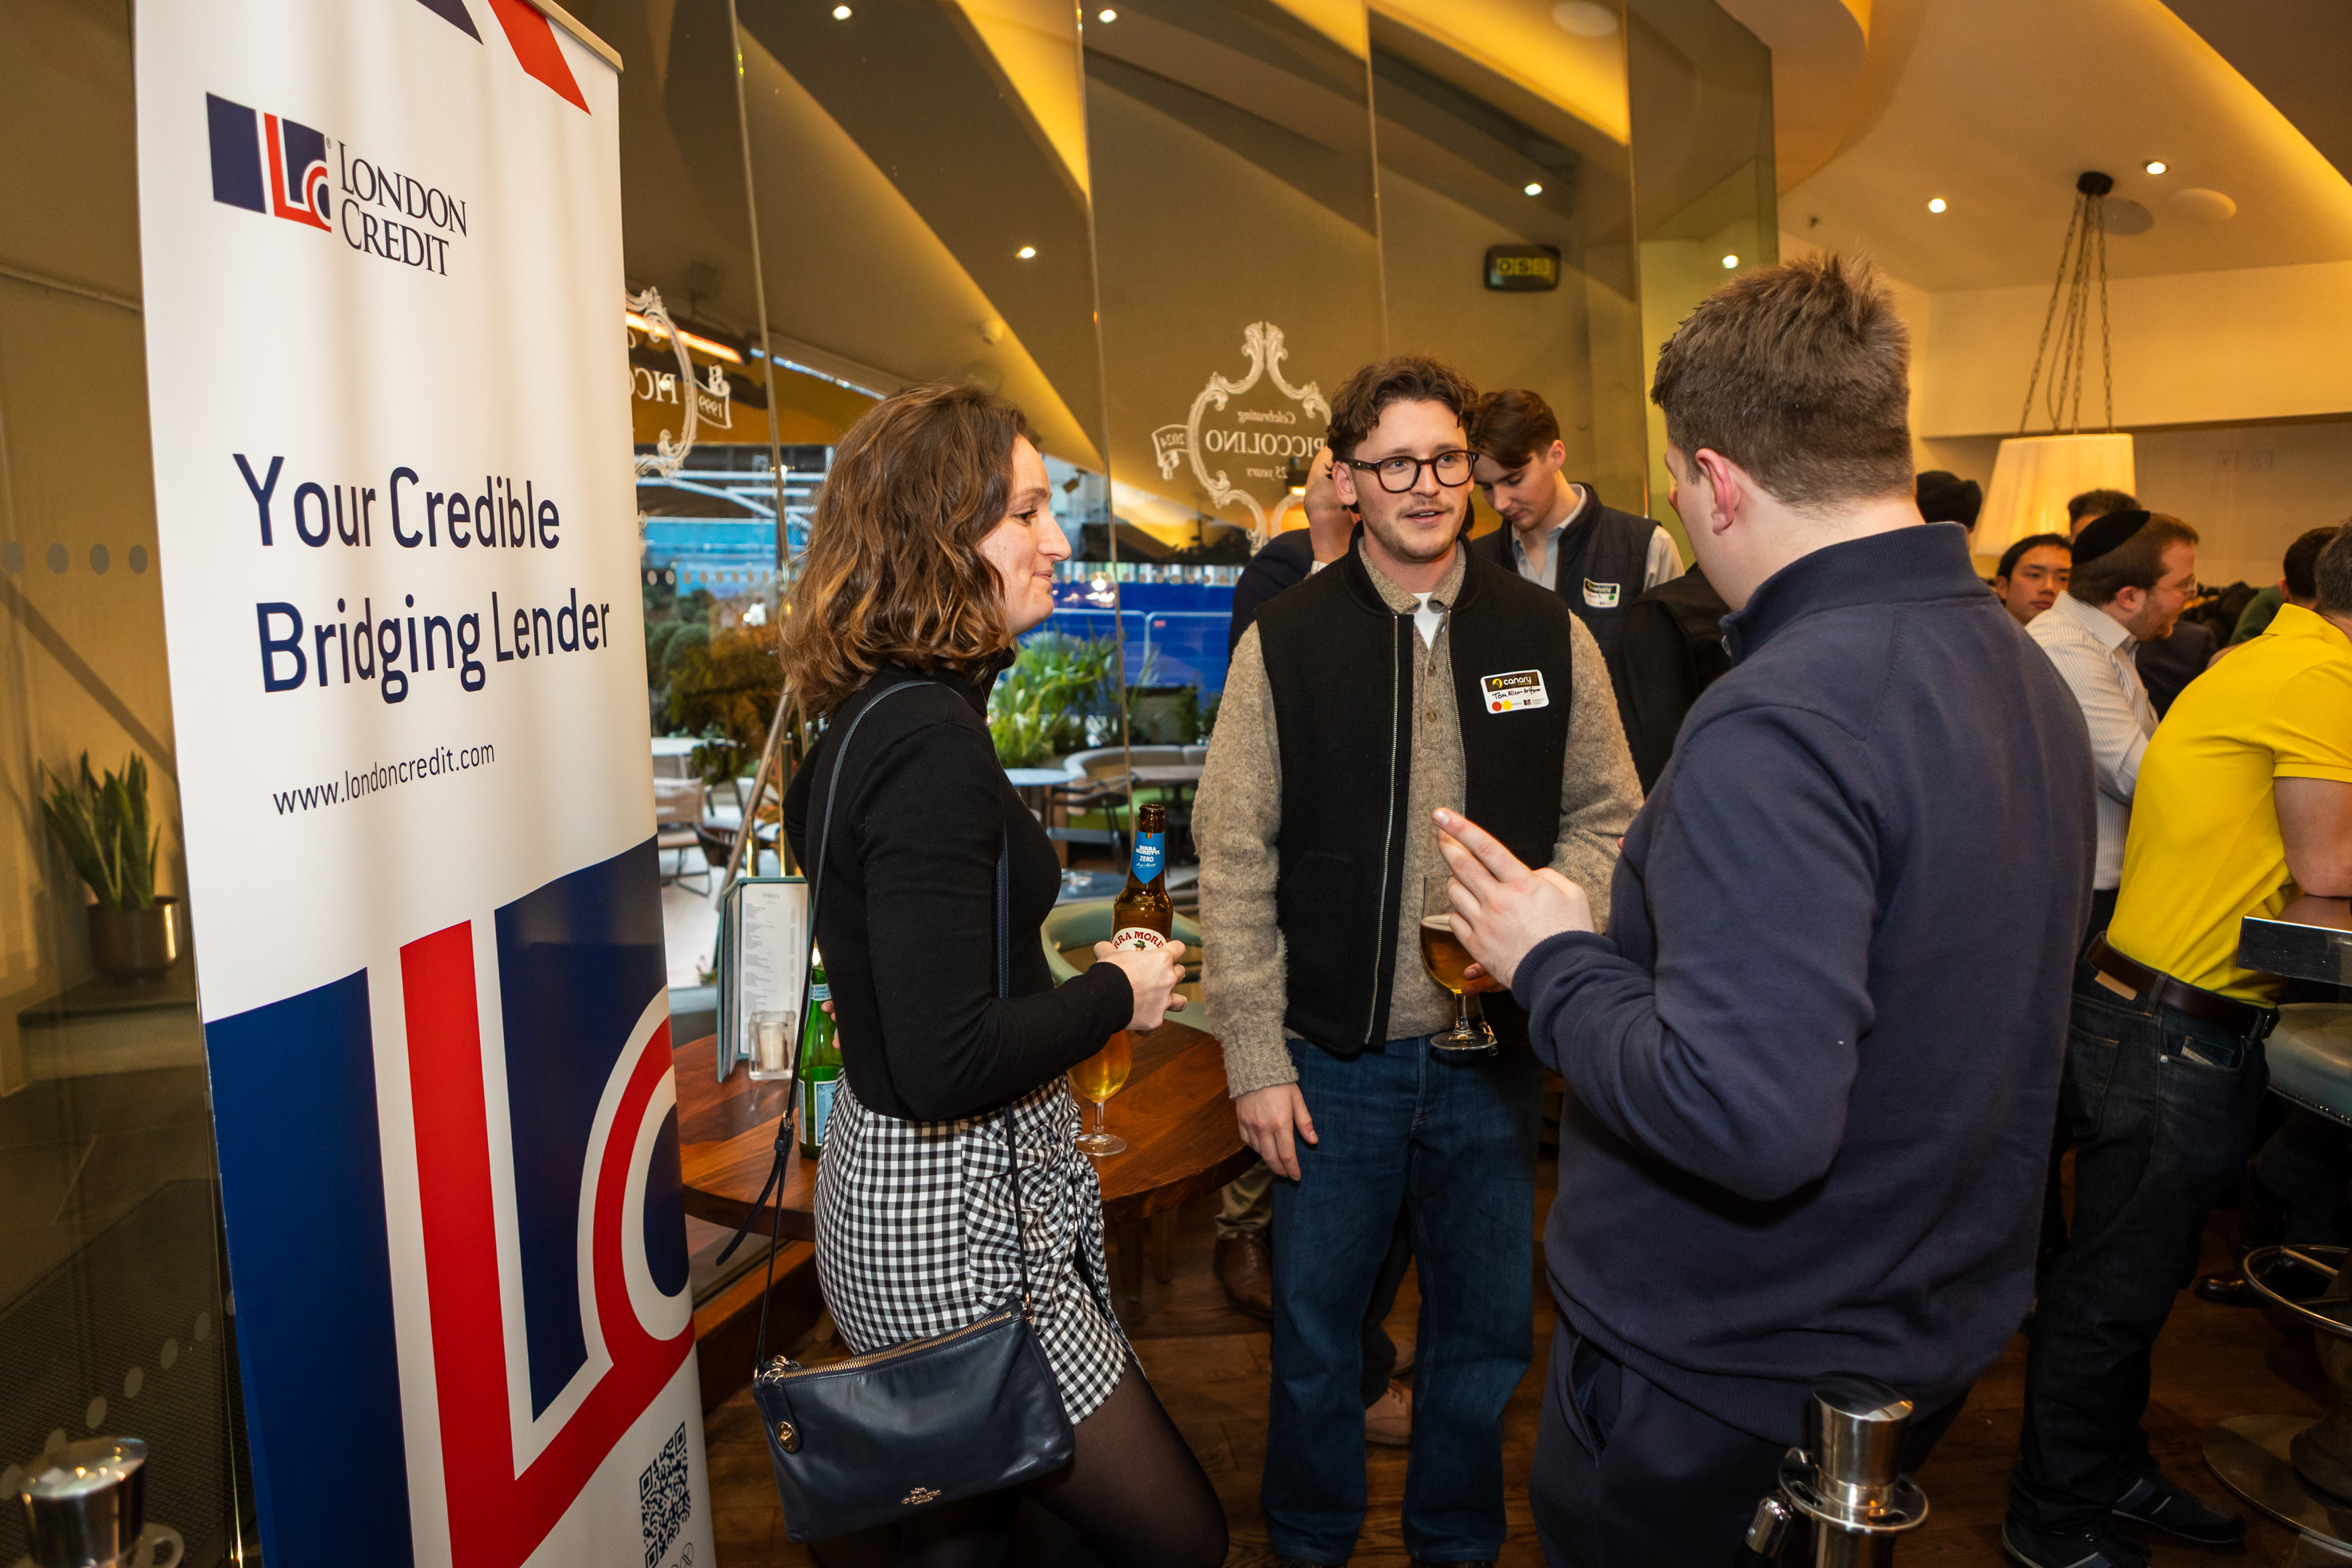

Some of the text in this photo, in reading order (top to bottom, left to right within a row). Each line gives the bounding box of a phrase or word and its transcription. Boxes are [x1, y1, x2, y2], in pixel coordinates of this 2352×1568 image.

[338, 140, 467, 237] LONDON
[341, 199, 449, 277] CREDIT
[232, 453, 560, 550] Your Credible
[256, 587, 610, 704] Bridging Lender
[273, 742, 496, 816] www.londoncredit.com
[1114, 931, 1164, 950] RRA MORE
